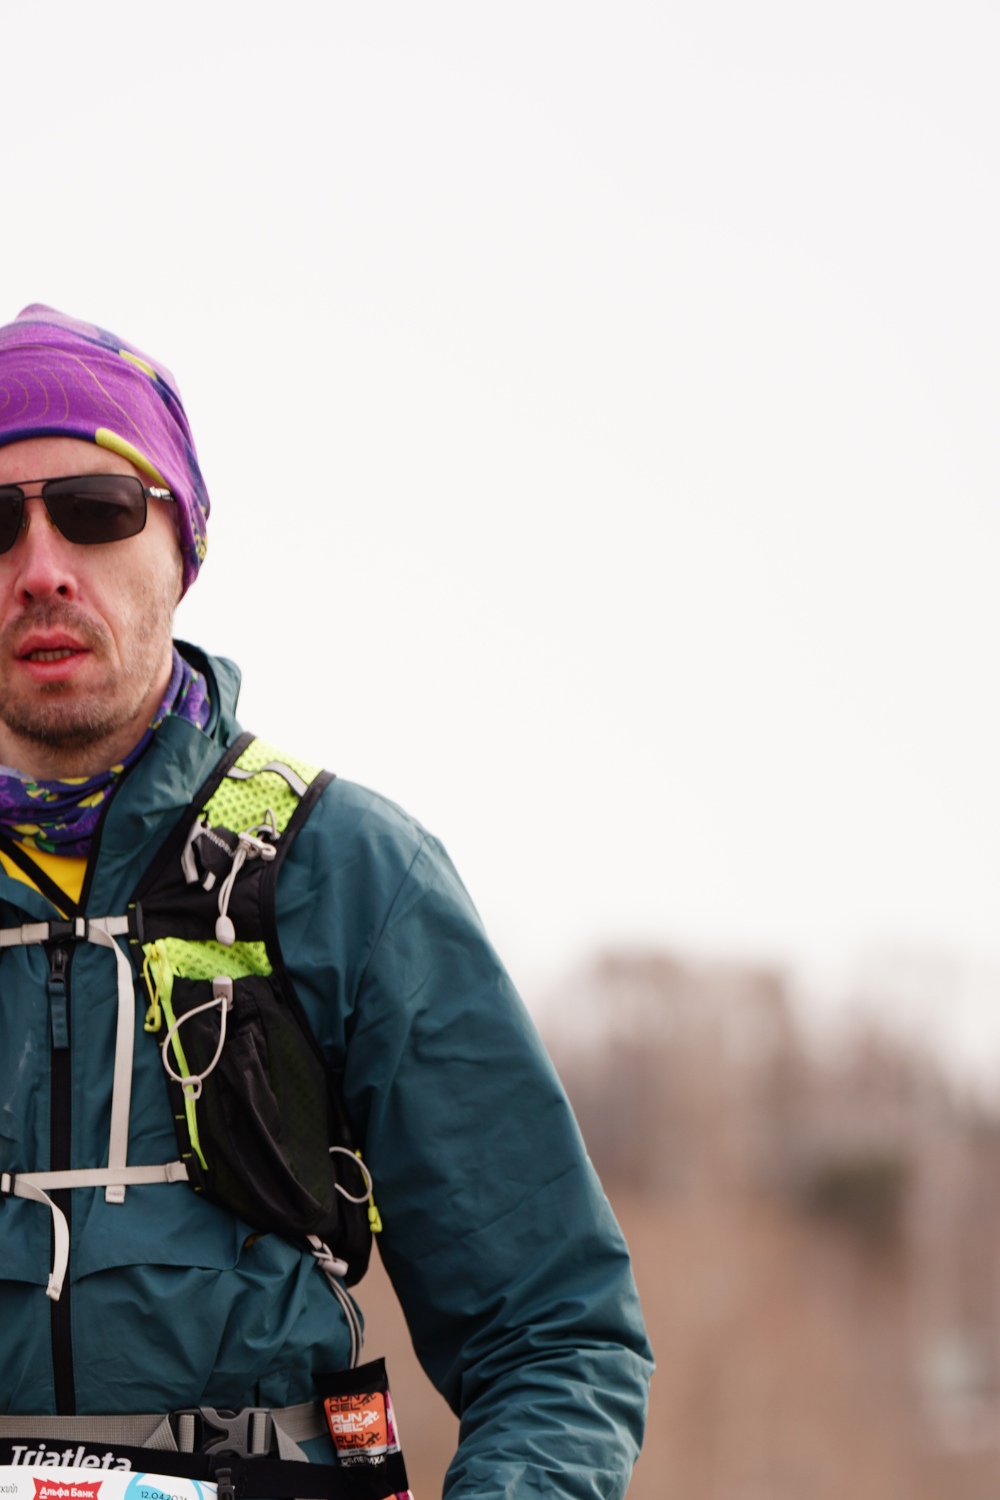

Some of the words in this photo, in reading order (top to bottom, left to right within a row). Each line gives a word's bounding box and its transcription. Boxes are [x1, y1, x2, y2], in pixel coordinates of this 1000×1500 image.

[331, 1412, 363, 1425] RUN
[333, 1422, 364, 1434] GEL
[336, 1433, 365, 1444] RUN
[11, 1443, 132, 1472] Triatleta
[39, 1486, 70, 1499] Альфа
[70, 1487, 94, 1499] Банк
